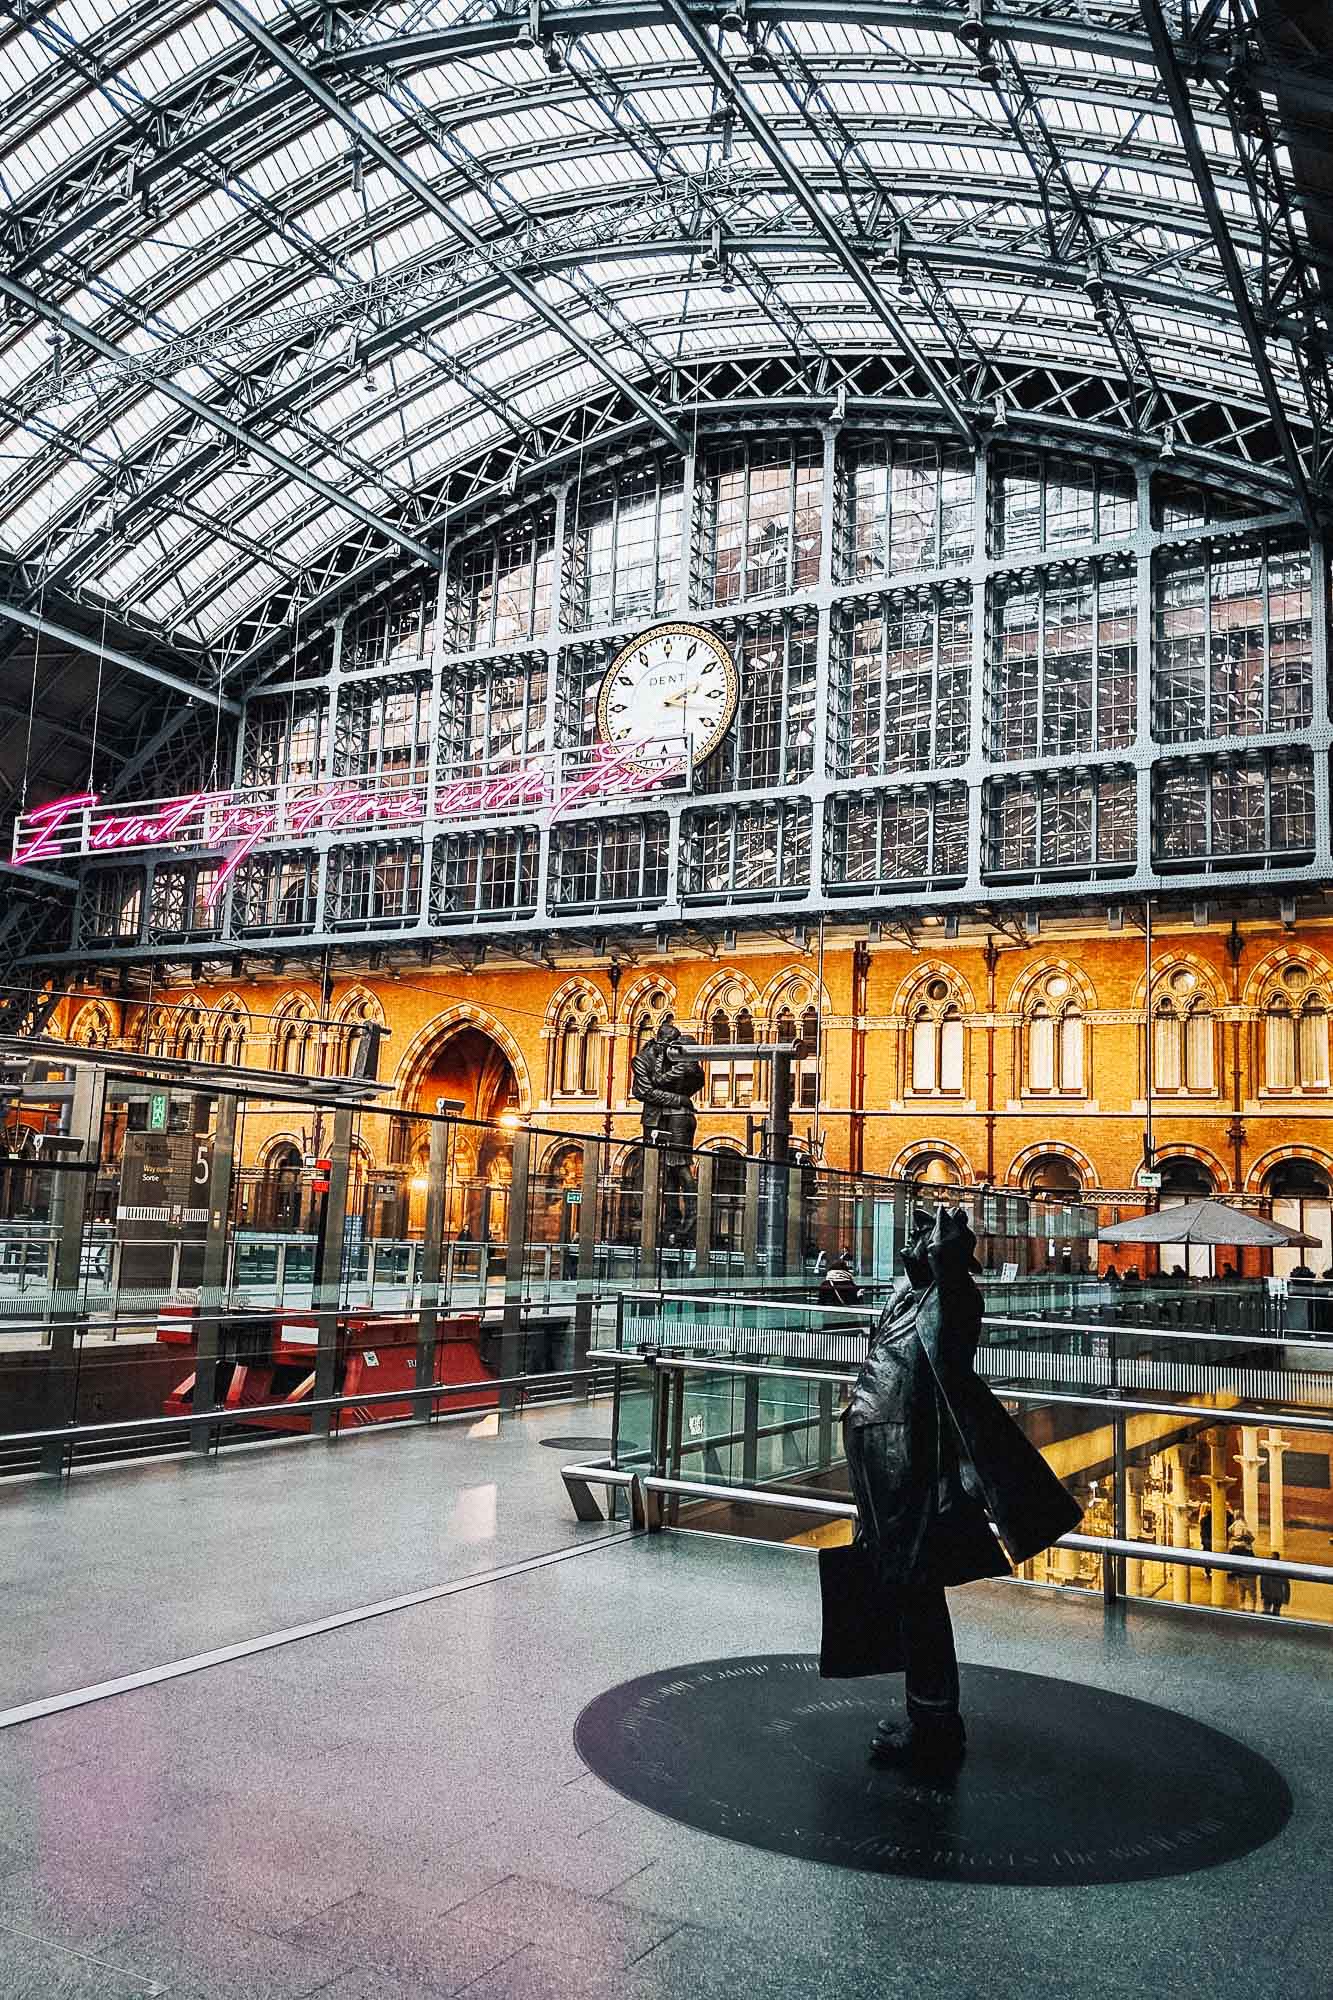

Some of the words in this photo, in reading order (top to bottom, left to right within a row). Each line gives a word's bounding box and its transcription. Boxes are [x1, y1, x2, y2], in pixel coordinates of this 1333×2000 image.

[649, 673, 684, 686] DENT
[12, 796, 97, 864] I
[208, 811, 275, 906] my
[290, 787, 423, 833] time
[440, 768, 552, 813] with
[193, 1146, 209, 1184] 5
[142, 1174, 160, 1182] Sortie
